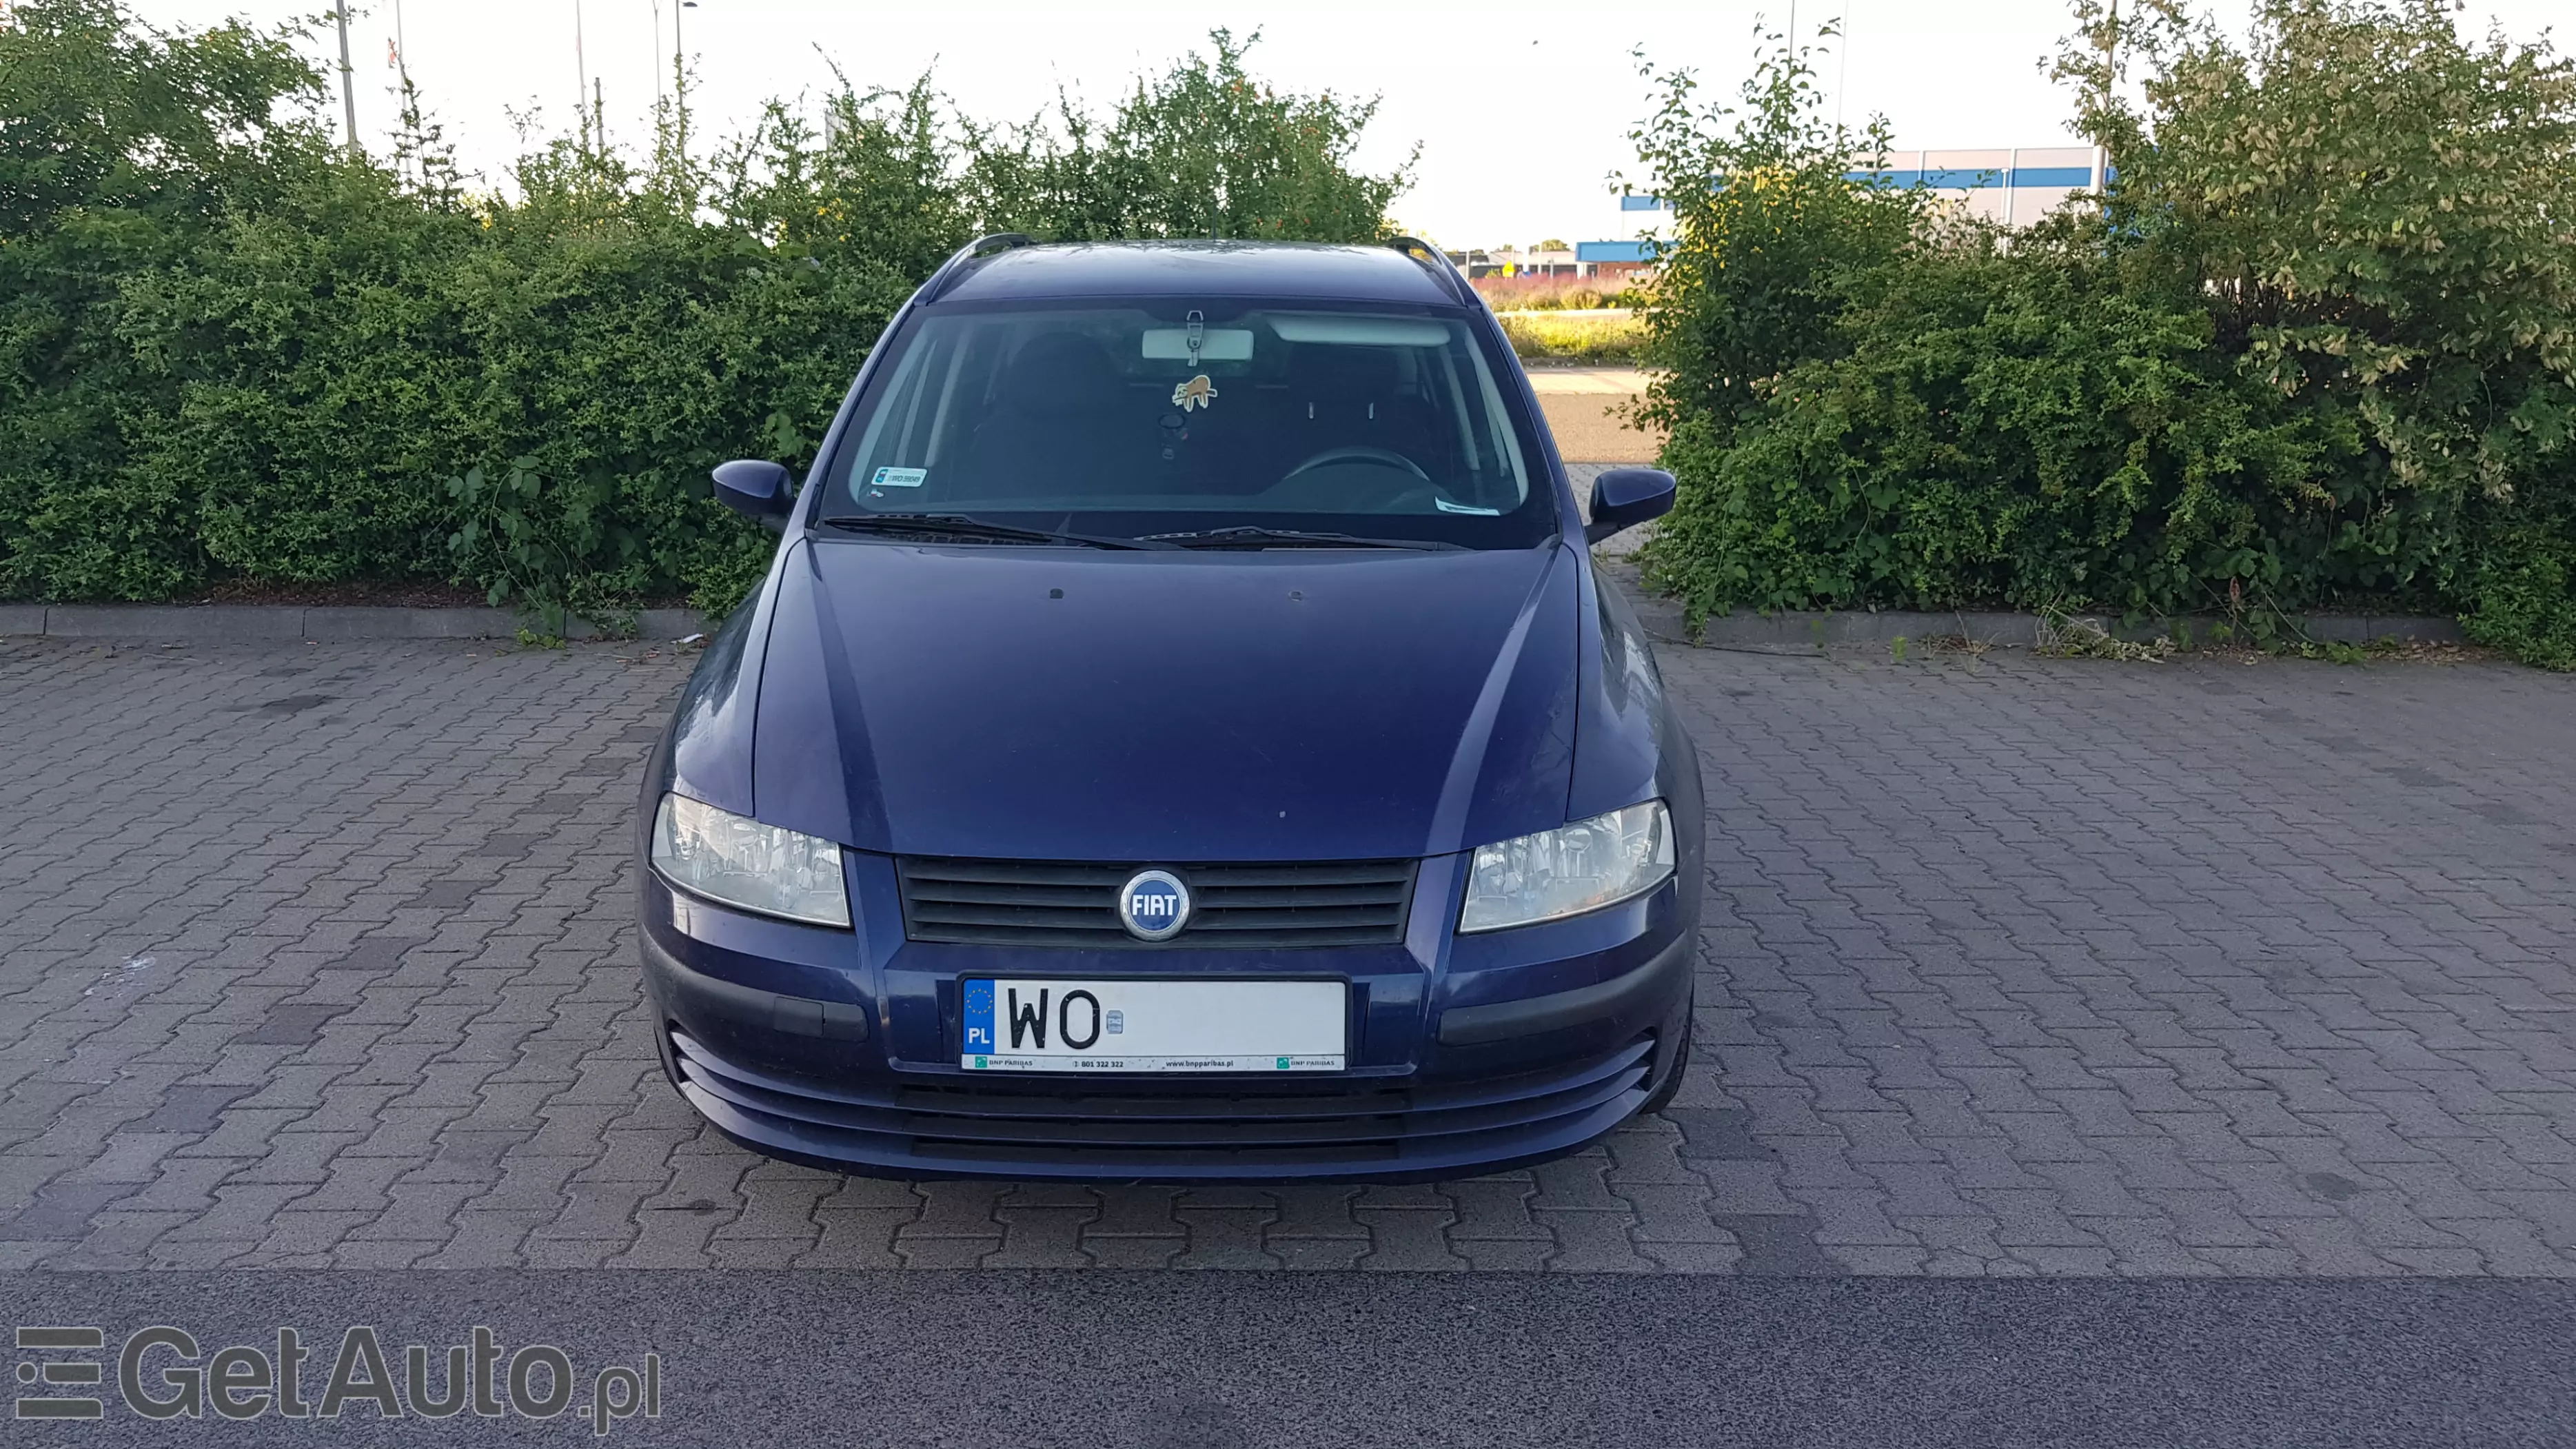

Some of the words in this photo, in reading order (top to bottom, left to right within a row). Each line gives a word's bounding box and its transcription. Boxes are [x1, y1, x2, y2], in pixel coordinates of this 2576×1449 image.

[1132, 894, 1177, 916] FIAT
[1008, 987, 1101, 1050] WO
[968, 1028, 990, 1044] PL
[1166, 1060, 1233, 1068] www.bnpparibas.pl
